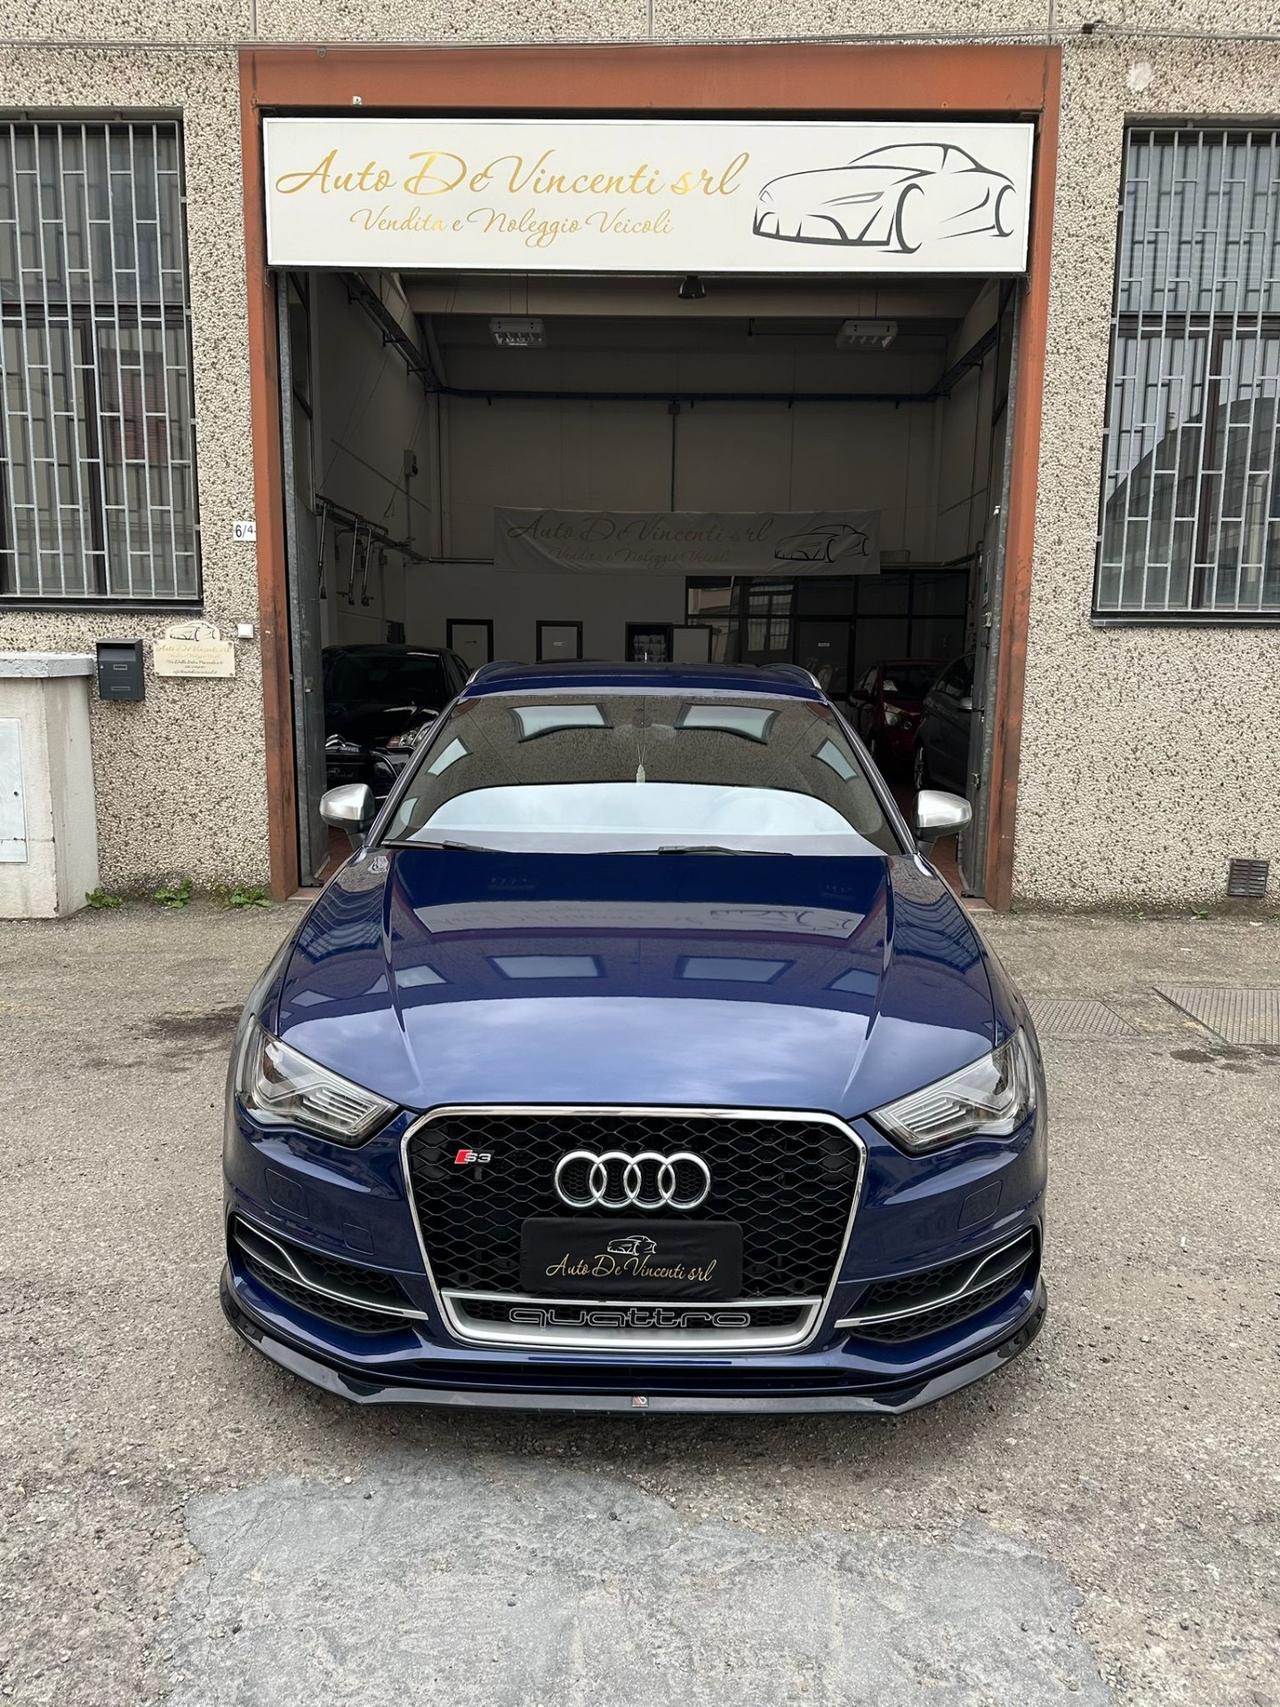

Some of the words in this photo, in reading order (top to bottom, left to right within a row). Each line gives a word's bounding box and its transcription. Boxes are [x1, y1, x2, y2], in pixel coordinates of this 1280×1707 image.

[276, 149, 398, 194] Auto
[403, 151, 491, 196] De
[483, 149, 665, 196] Vincenti
[670, 152, 751, 196] srl
[349, 205, 447, 233] Vendita
[452, 218, 464, 232] e
[466, 207, 582, 249] Noleggio
[584, 207, 675, 234] Veicoli
[506, 513, 576, 540] Auto
[464, 1152, 492, 1163] S3
[546, 1253, 591, 1276] Auto
[592, 1254, 623, 1278] De
[624, 1254, 685, 1280] Vincenti
[687, 1258, 717, 1282] srl
[509, 1306, 750, 1328] quattro
